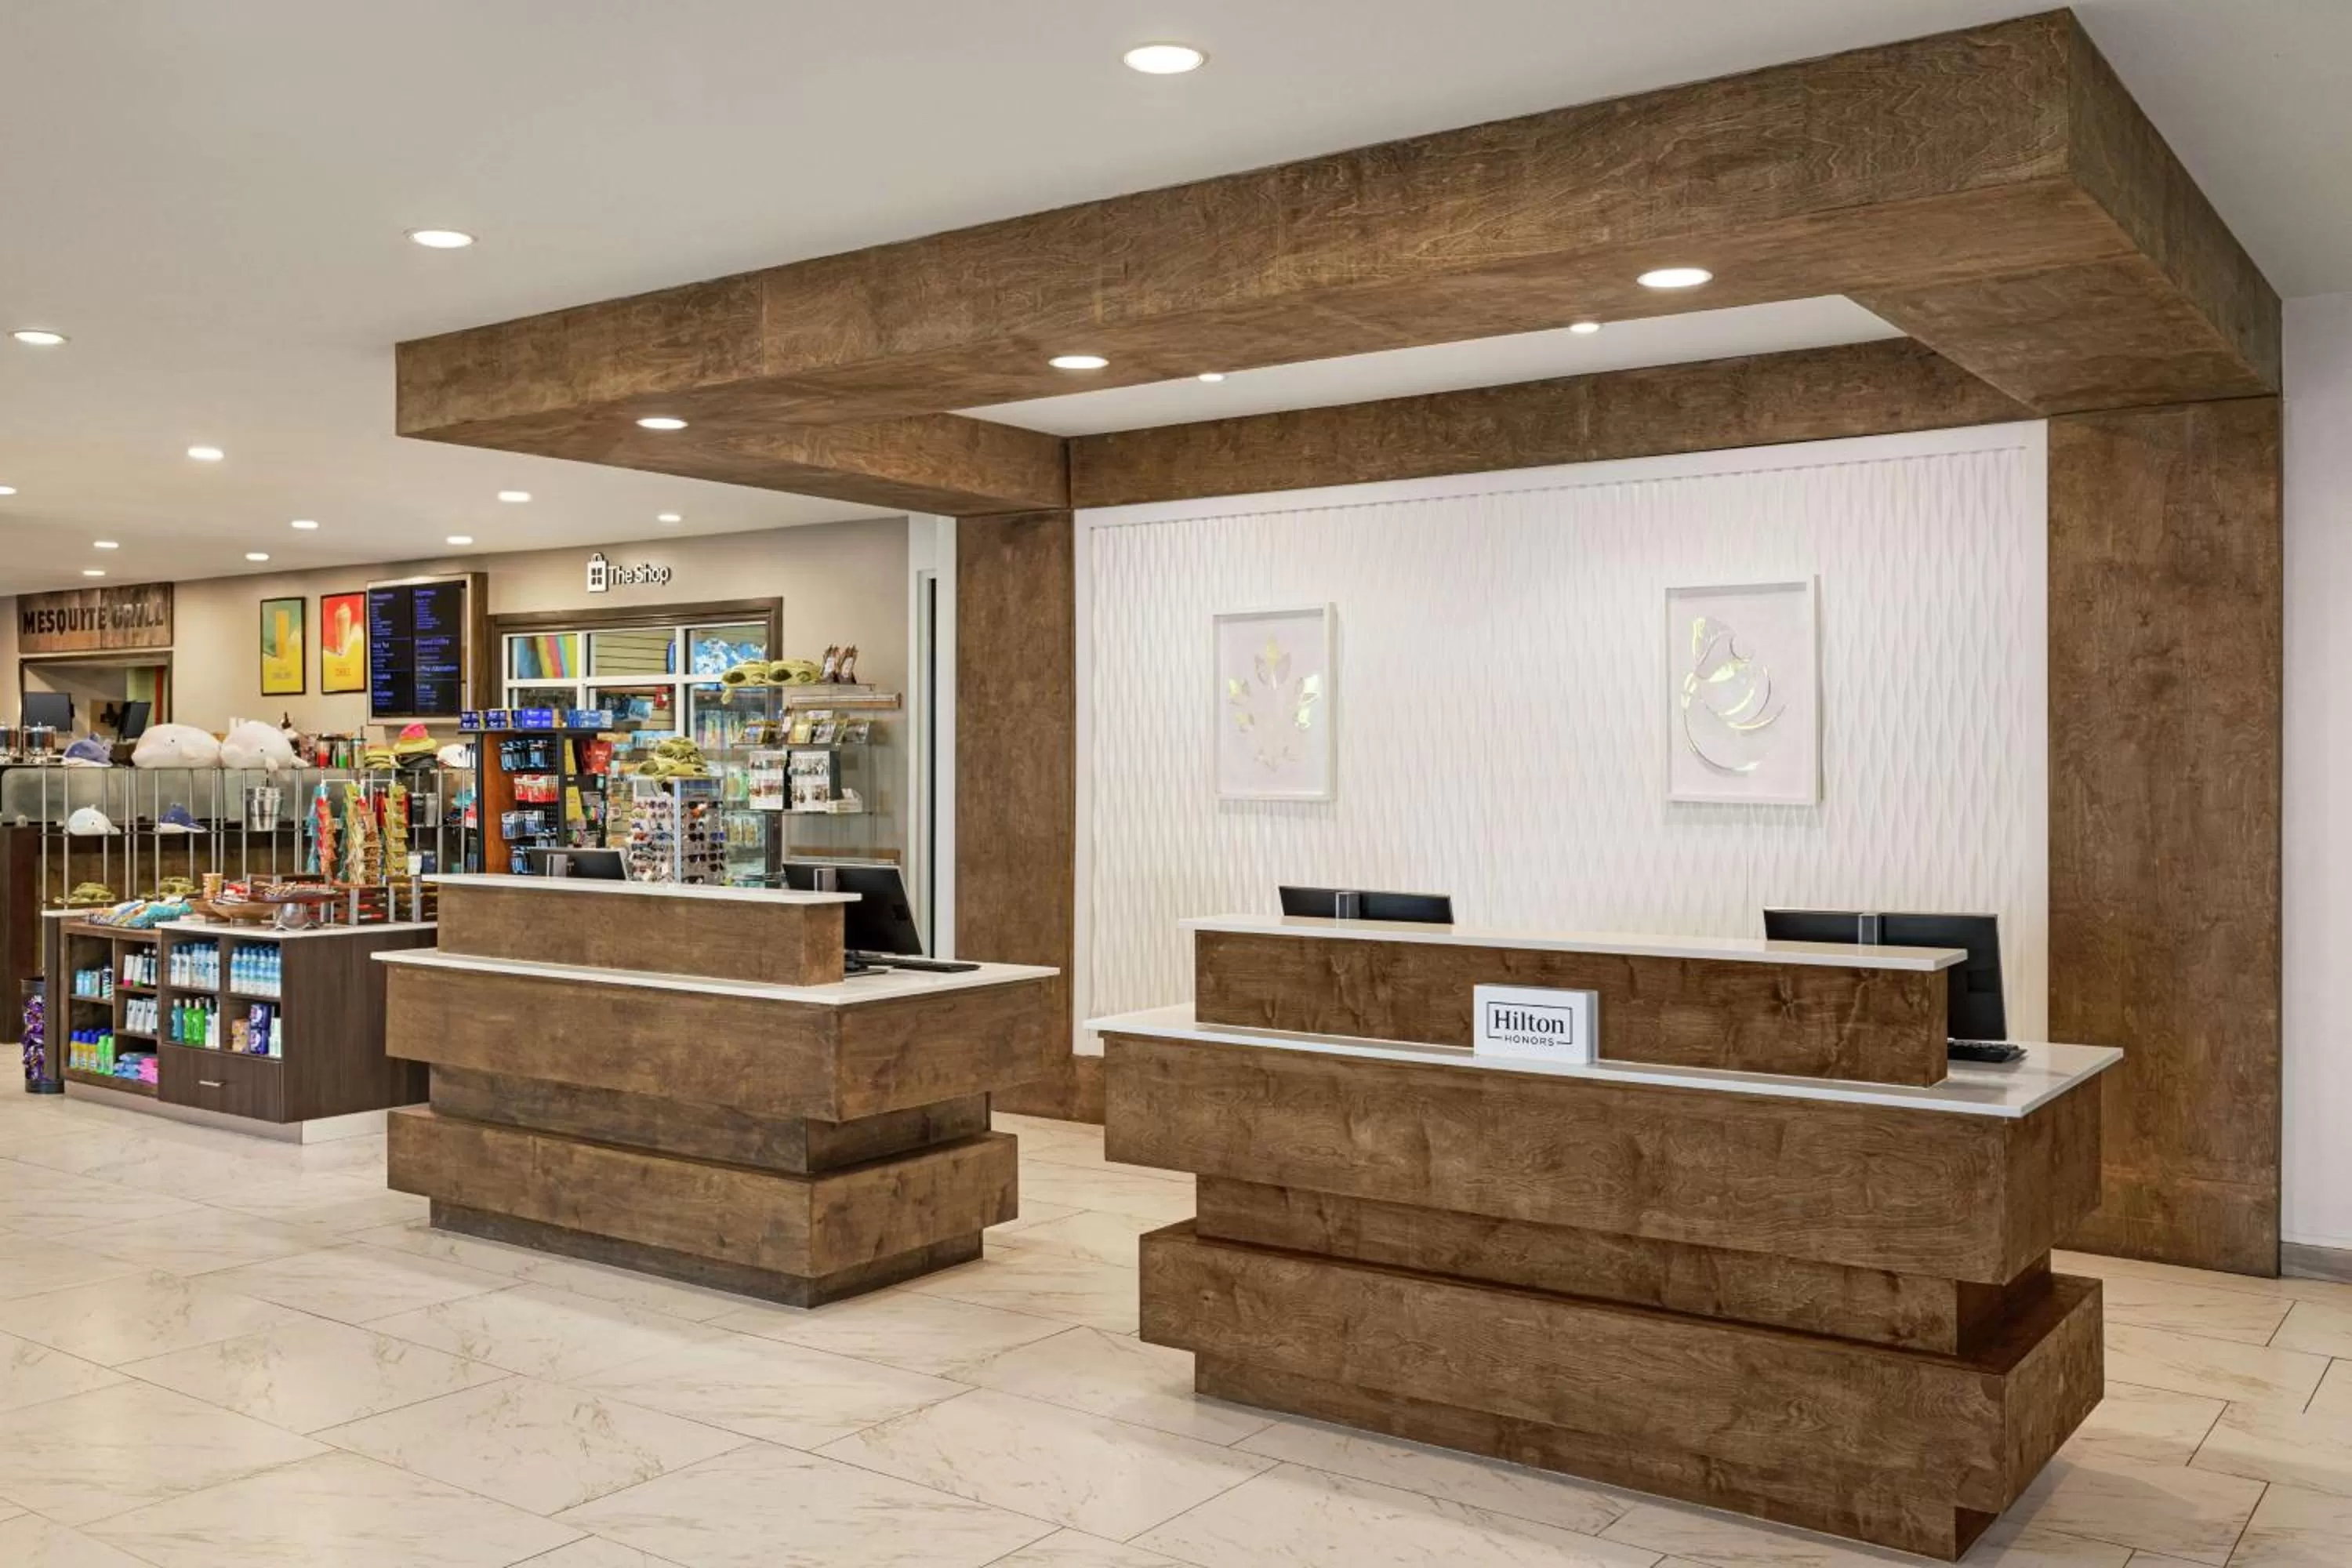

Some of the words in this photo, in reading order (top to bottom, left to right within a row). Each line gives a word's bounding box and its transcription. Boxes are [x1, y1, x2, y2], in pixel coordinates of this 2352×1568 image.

[608, 564, 633, 585] The
[634, 564, 670, 586] Shop
[23, 607, 107, 635] MESQUITE
[111, 603, 164, 630] GRILL
[1494, 1009, 1565, 1034] Hilton
[1504, 1034, 1555, 1047] HONORS
